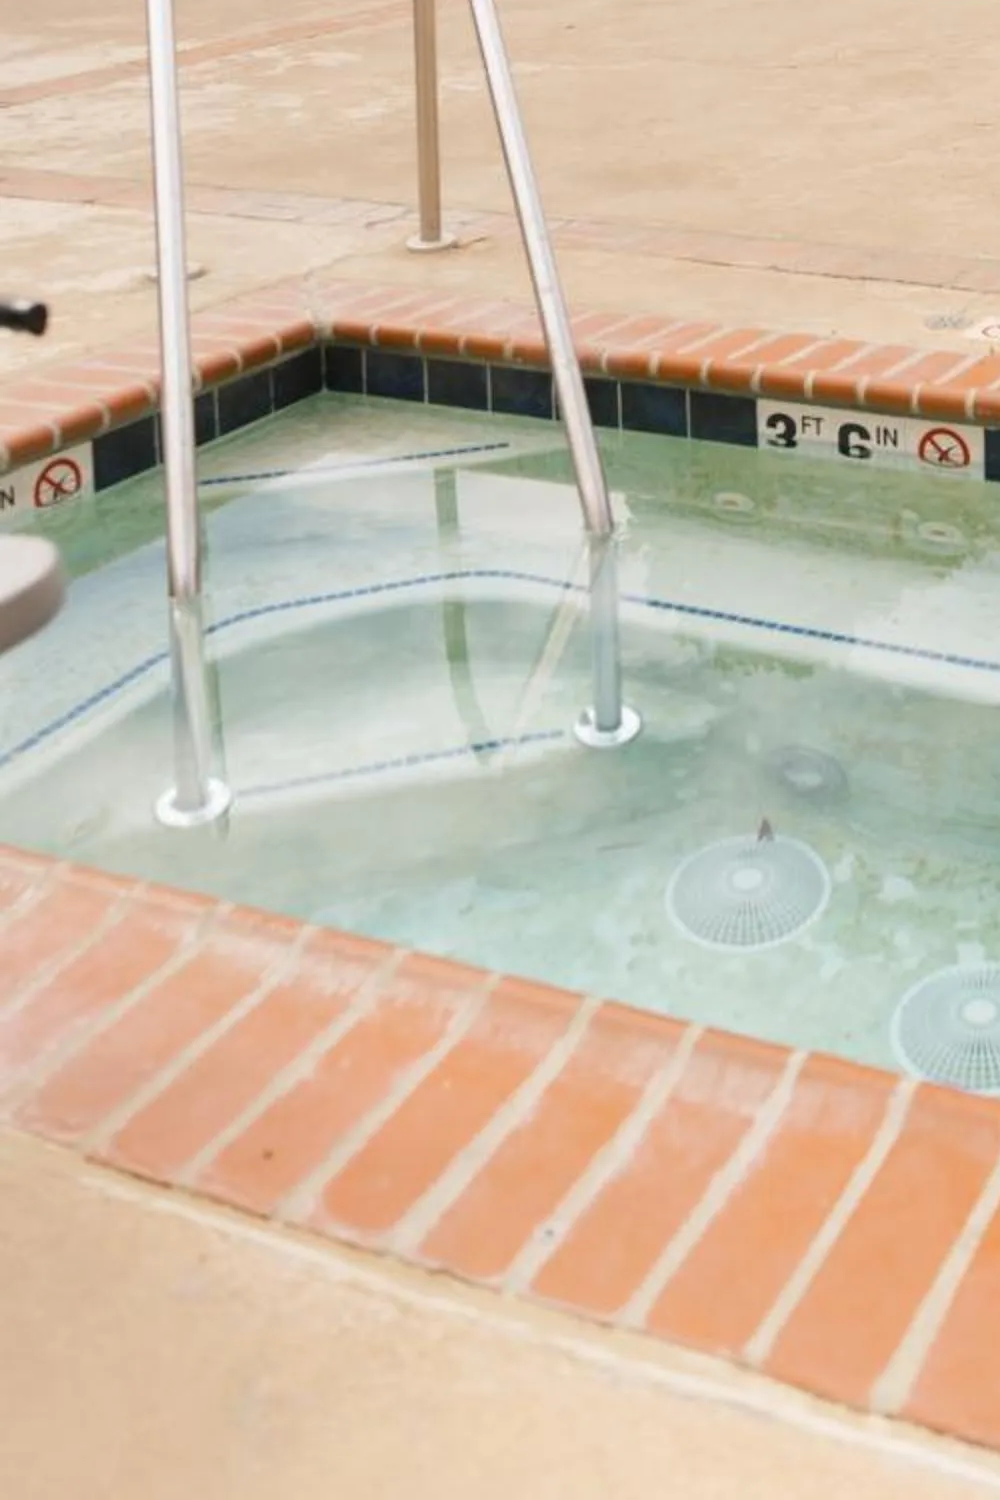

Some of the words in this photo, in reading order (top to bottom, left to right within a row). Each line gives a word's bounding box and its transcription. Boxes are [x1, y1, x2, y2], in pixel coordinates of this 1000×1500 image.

[766, 412, 798, 449] 3
[801, 416, 825, 436] FT
[838, 422, 873, 459] 6
[875, 425, 899, 448] IN
